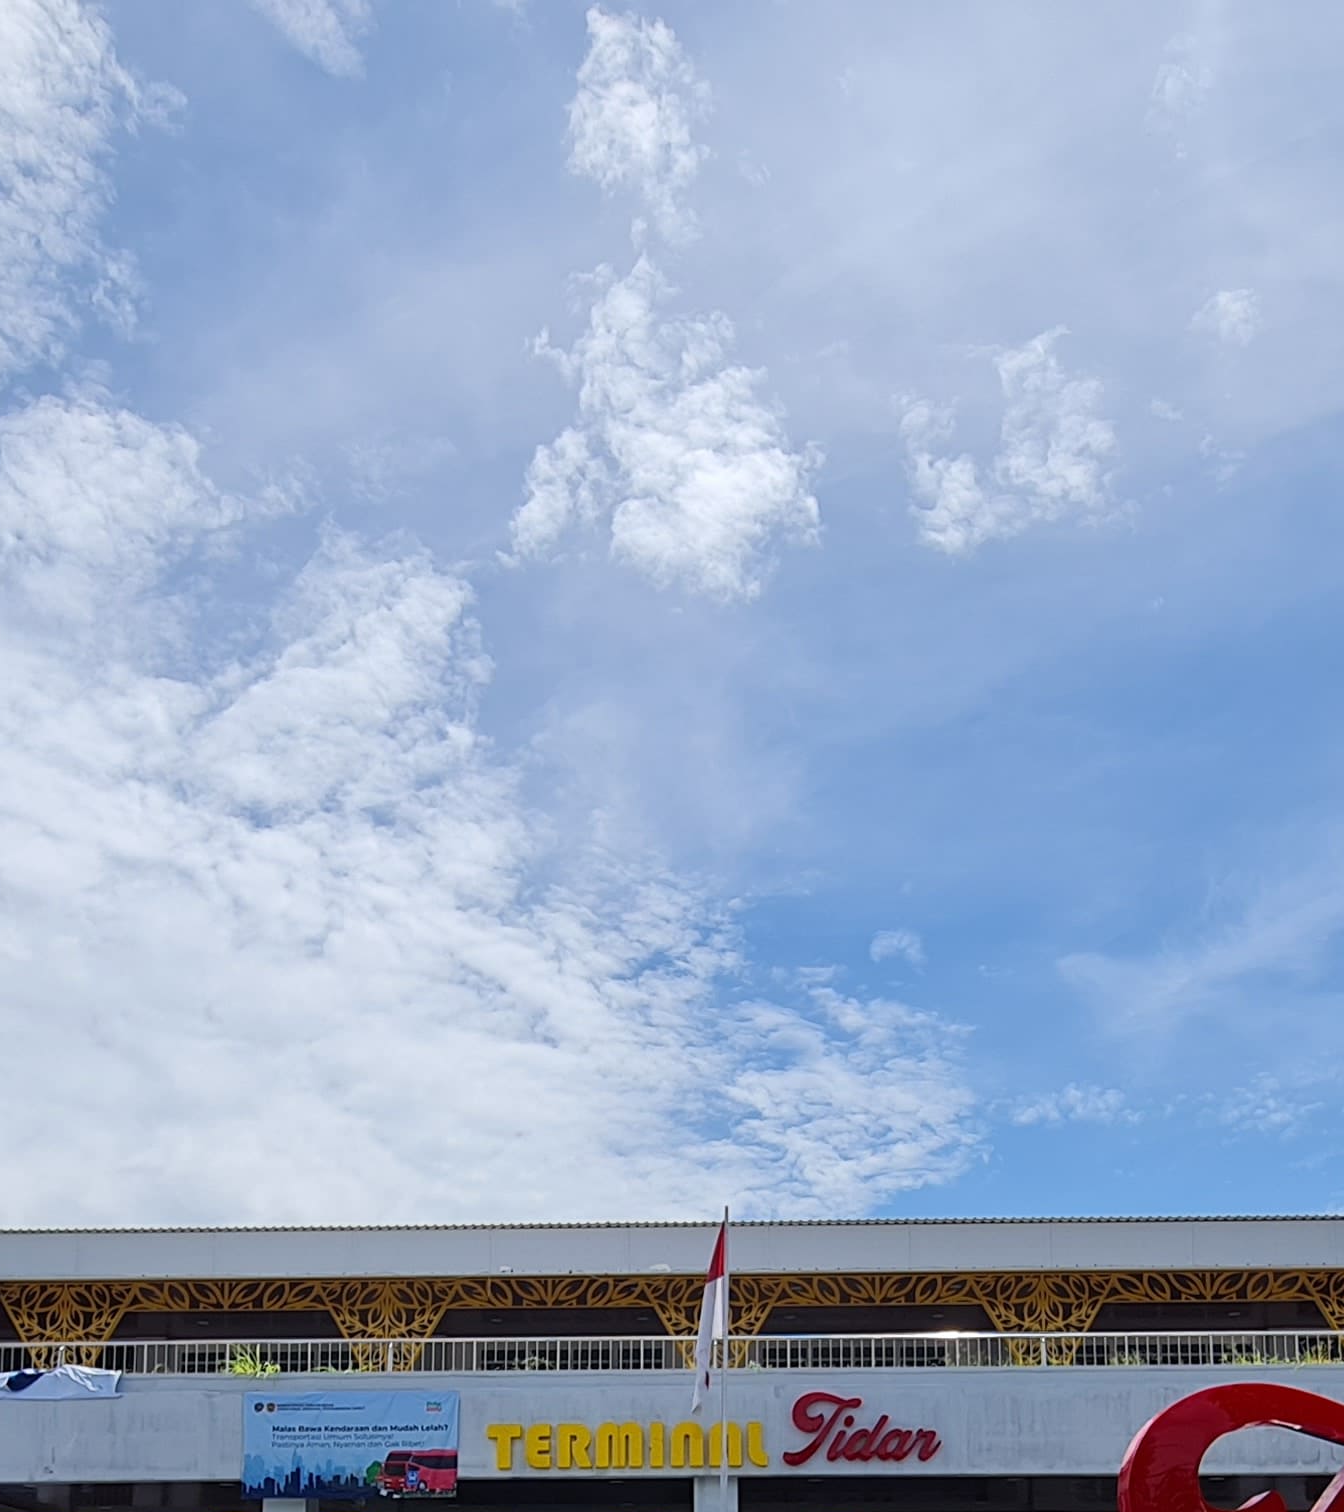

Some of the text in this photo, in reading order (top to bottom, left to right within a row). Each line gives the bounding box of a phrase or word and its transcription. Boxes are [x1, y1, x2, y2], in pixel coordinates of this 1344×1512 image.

[272, 1425, 296, 1433] Malas
[298, 1425, 322, 1433] Bawa
[324, 1425, 370, 1433] Kendaraan
[390, 1424, 419, 1432] Mudah
[421, 1424, 449, 1432] Lelah?
[486, 1391, 943, 1470] TERMINAL Tidar
